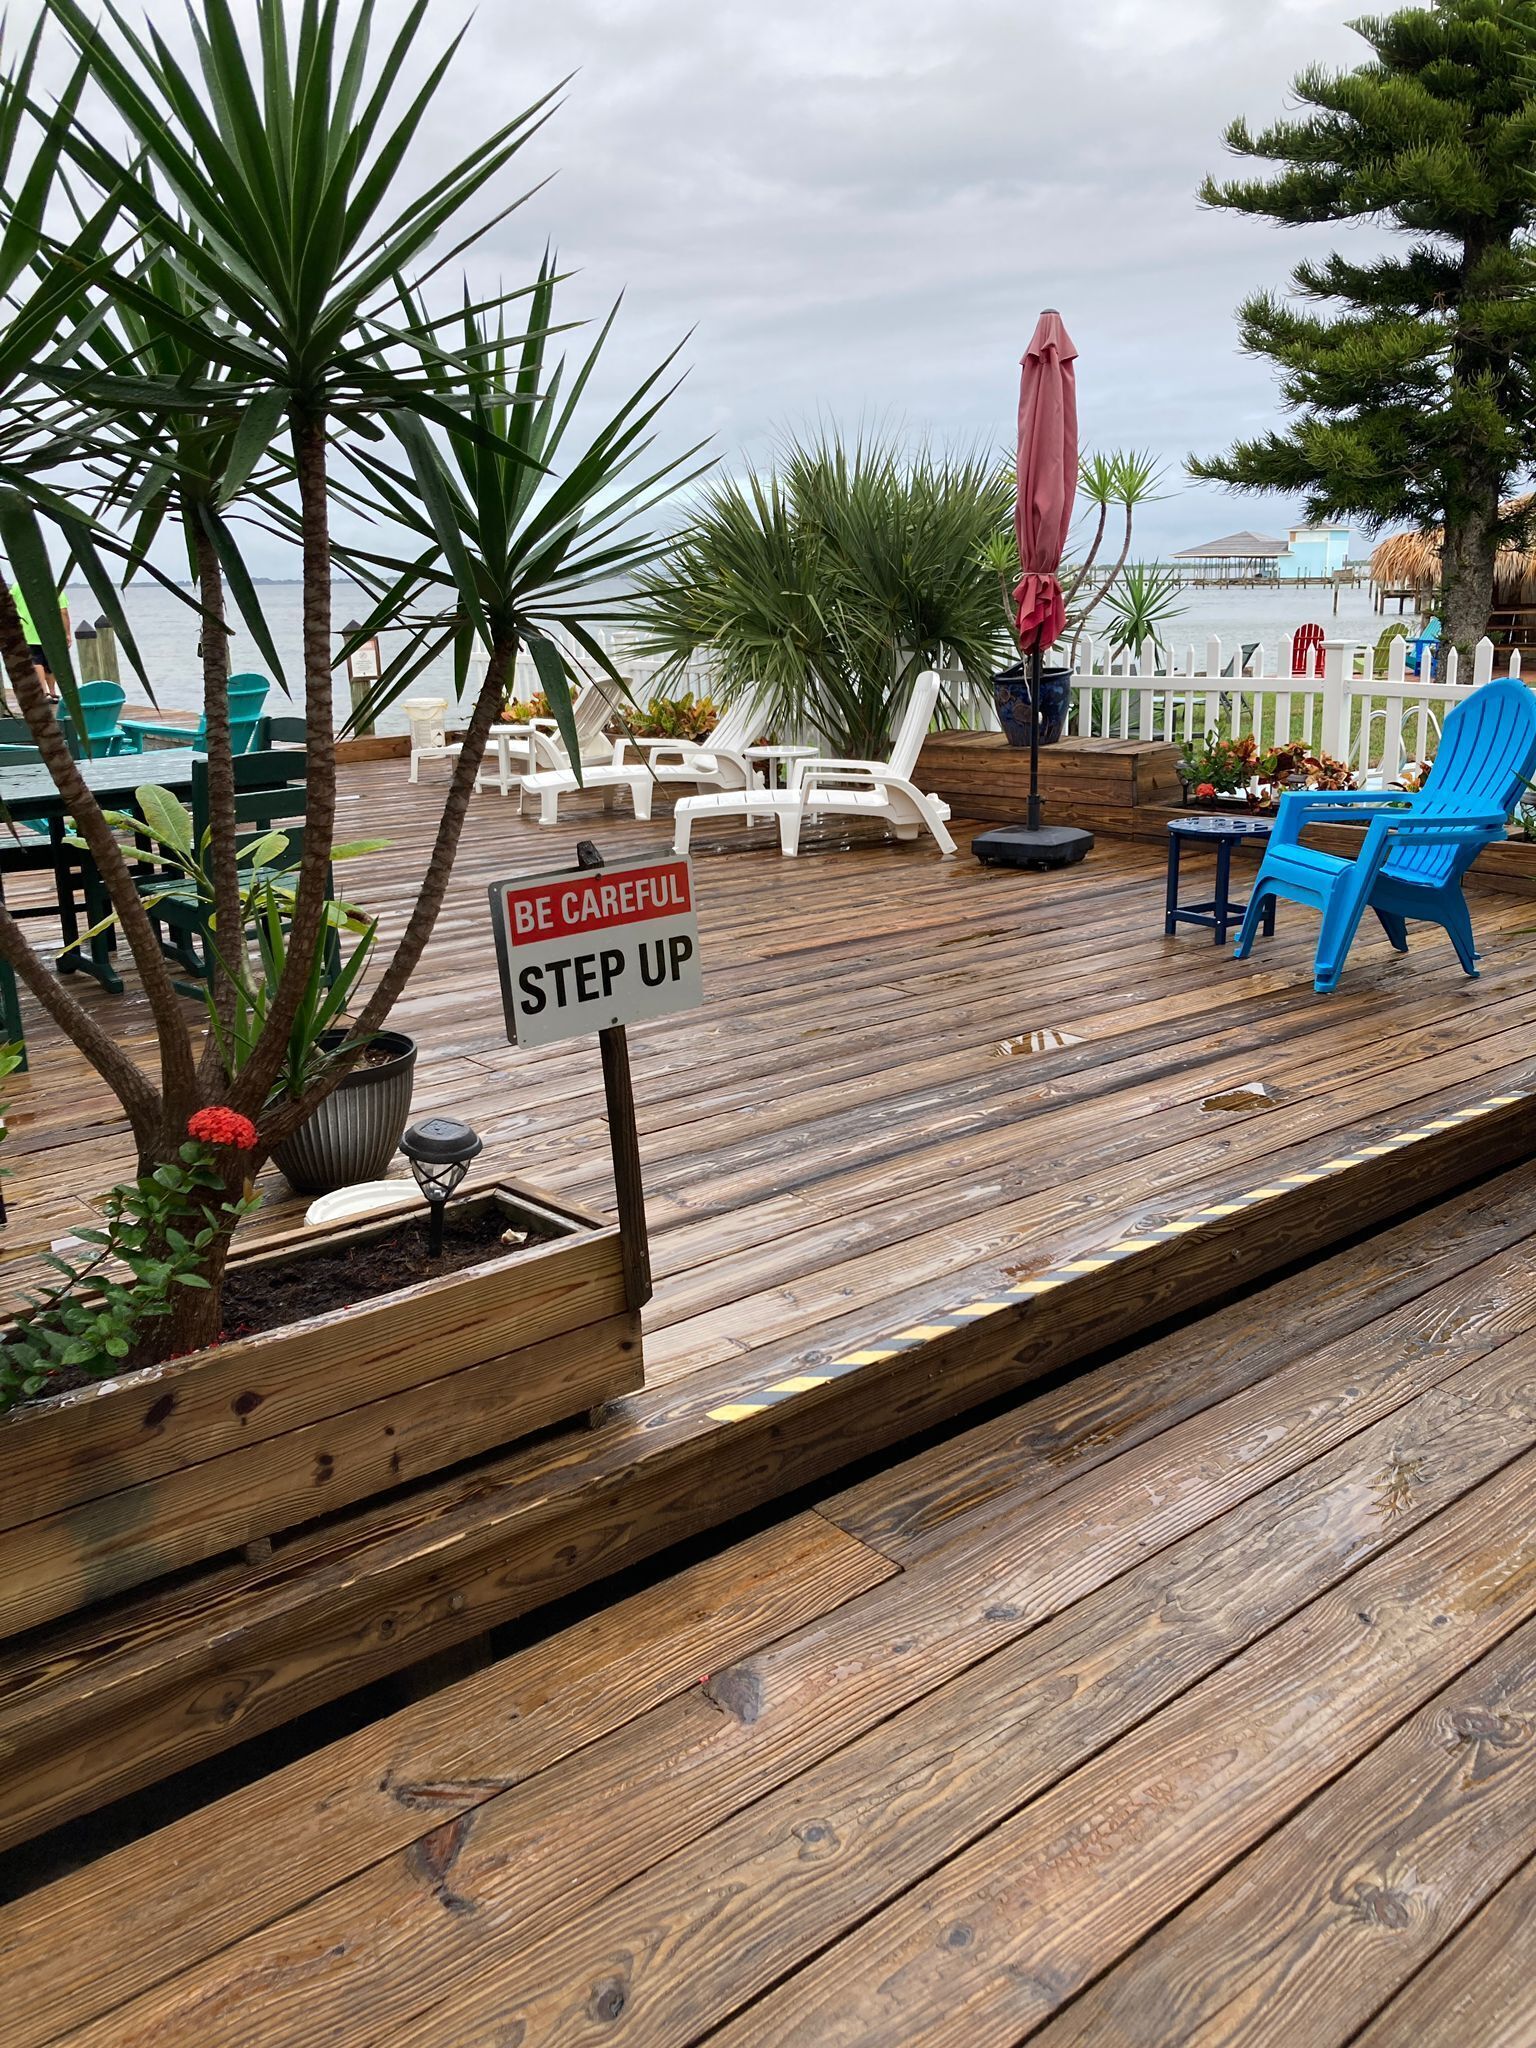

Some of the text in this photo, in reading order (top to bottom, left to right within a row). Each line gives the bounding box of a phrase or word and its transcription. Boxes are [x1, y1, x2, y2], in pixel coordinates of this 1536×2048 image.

[514, 874, 685, 934] BE CAREFUL
[518, 935, 693, 1015] STEP UP
